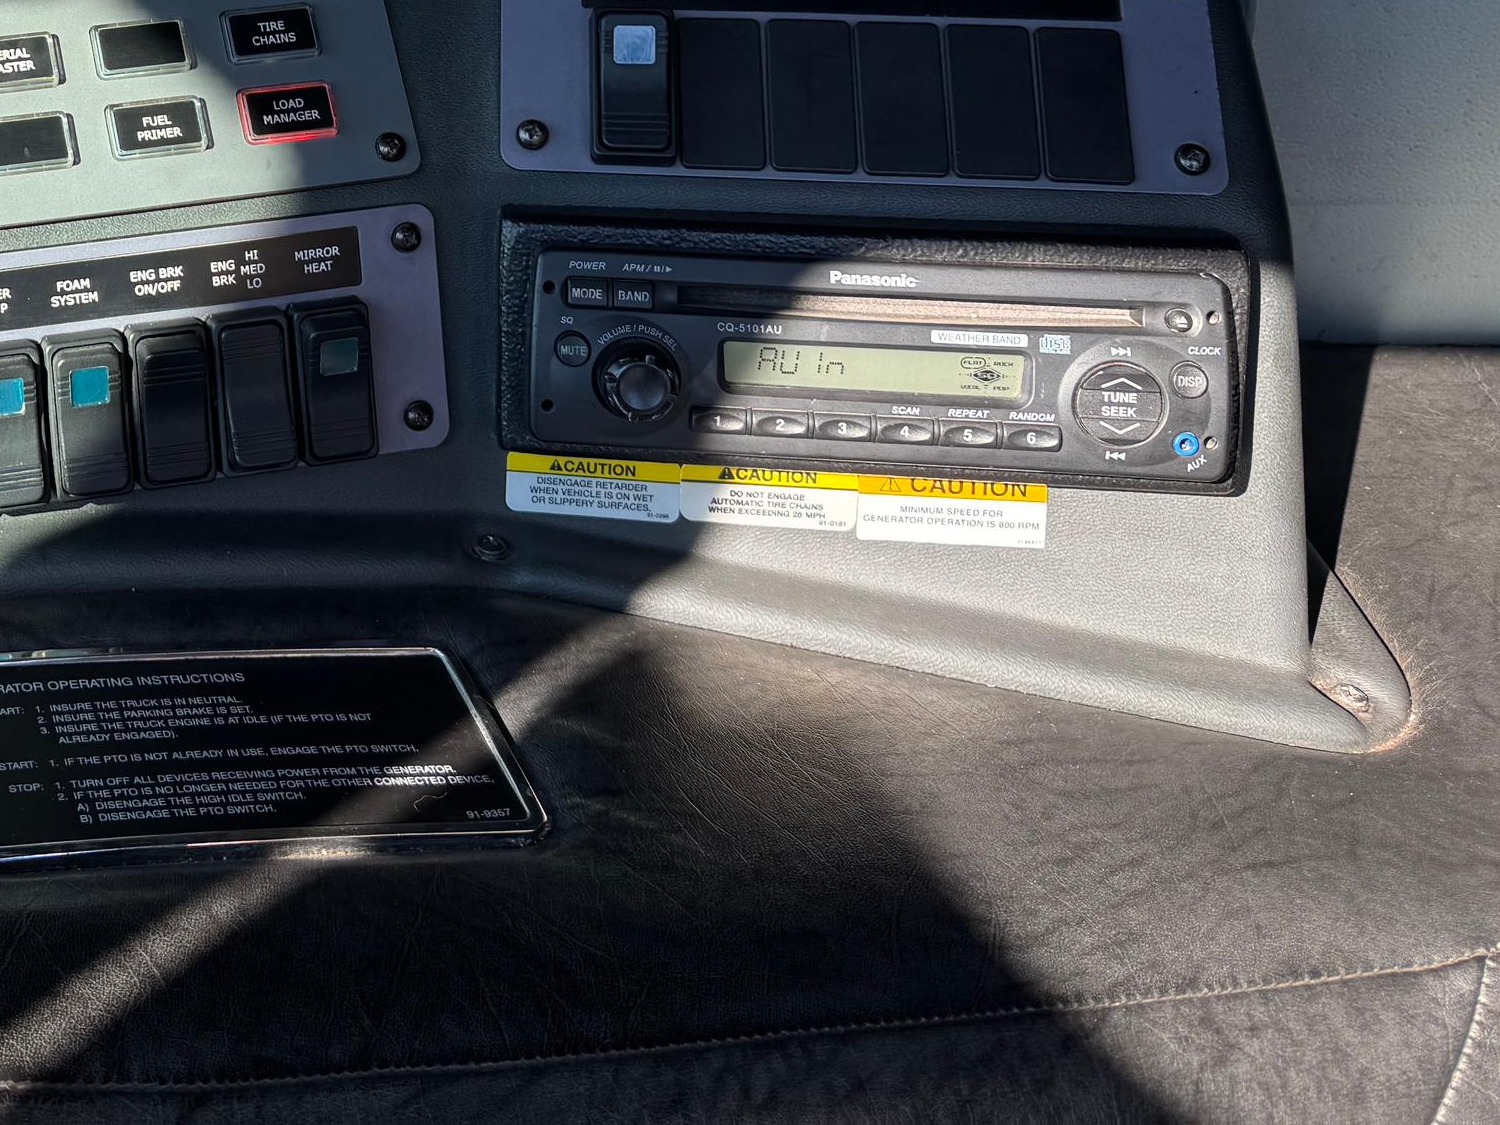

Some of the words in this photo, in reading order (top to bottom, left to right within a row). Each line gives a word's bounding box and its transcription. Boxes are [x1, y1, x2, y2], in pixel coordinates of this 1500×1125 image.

[258, 21, 285, 32] TIRE
[252, 33, 296, 46] CHAINS
[273, 98, 304, 110] LOAD
[142, 115, 172, 126] FUEL
[263, 110, 320, 125] MANAGER
[137, 127, 182, 142] PRIMER
[245, 250, 258, 260] HI
[294, 246, 340, 261] MIRROR
[211, 260, 235, 272] ENG
[241, 264, 265, 276] MED
[304, 261, 333, 274] HEAT
[569, 261, 606, 270] POWER
[623, 263, 644, 272] APM
[130, 270, 155, 282] ENG
[159, 266, 184, 278] BRK
[212, 274, 236, 286] BRK
[830, 271, 917, 288] Panasonic
[56, 278, 91, 292] FOAM
[135, 280, 181, 297] ON/OFF
[247, 278, 262, 288] LO
[51, 292, 99, 307] SYSTEM
[572, 287, 602, 300] MODE
[618, 290, 649, 301] BAND
[561, 316, 573, 325] SQ
[717, 323, 782, 335] CQ-5101AU
[598, 325, 630, 345] VOLUME
[638, 324, 663, 337] PUSH
[663, 335, 678, 351] SEL
[938, 333, 989, 343] WEATHER
[992, 335, 1021, 345] BAND
[560, 344, 587, 356] MUTE
[1188, 347, 1221, 355] CLOCK
[1178, 376, 1202, 387] DISP
[1103, 392, 1137, 403] TUNE
[892, 406, 920, 415] SCAN
[949, 409, 989, 419] REPEAT
[1101, 406, 1136, 418] SEEK
[714, 416, 720, 427] 1
[1009, 412, 1055, 422] RANDOM
[776, 419, 785, 431] 2
[837, 423, 846, 434] 3
[900, 426, 909, 437] 4
[963, 429, 972, 441] 5
[1027, 432, 1036, 444] 6
[564, 461, 636, 477] CAUTION
[1187, 457, 1207, 472] AUX
[736, 468, 817, 484] CAUTION
[537, 477, 592, 488] DISENGAGE
[595, 481, 648, 492] RETARDER
[911, 478, 1028, 497] CAUTION
[530, 486, 558, 495] WHEN
[561, 488, 600, 498] VEHICLE
[604, 491, 613, 499] IS
[616, 492, 630, 500] ON
[633, 493, 654, 502] WET
[768, 493, 805, 501] ENGAGE
[532, 496, 546, 504] OR
[548, 497, 594, 507] SLIPPERY
[597, 501, 651, 511] SURFACES.
[711, 497, 764, 507] AUTOMATIC
[708, 506, 735, 514] WHEN
[738, 508, 790, 517] EXCEEDING
[900, 506, 944, 514] MINIMUM
[947, 508, 980, 516] SPEED
[863, 515, 923, 524] GENERATOR
[927, 518, 983, 527] OPERATION
[987, 520, 996, 528] IS
[1018, 522, 1040, 530] RPM
[48, 677, 133, 691] OPERATING
[137, 673, 245, 686] INSTRUCTIONS
[35, 706, 44, 714] 1.
[50, 702, 93, 712] INSURE
[94, 701, 117, 709] THE
[119, 700, 158, 708] TRUCK
[161, 698, 172, 706] IS
[175, 697, 186, 705] IN
[188, 696, 243, 704] NEUTRAL.
[59, 734, 109, 744] ALREADY
[114, 730, 178, 741] ENGAGED).
[466, 808, 511, 819] 91-9357
